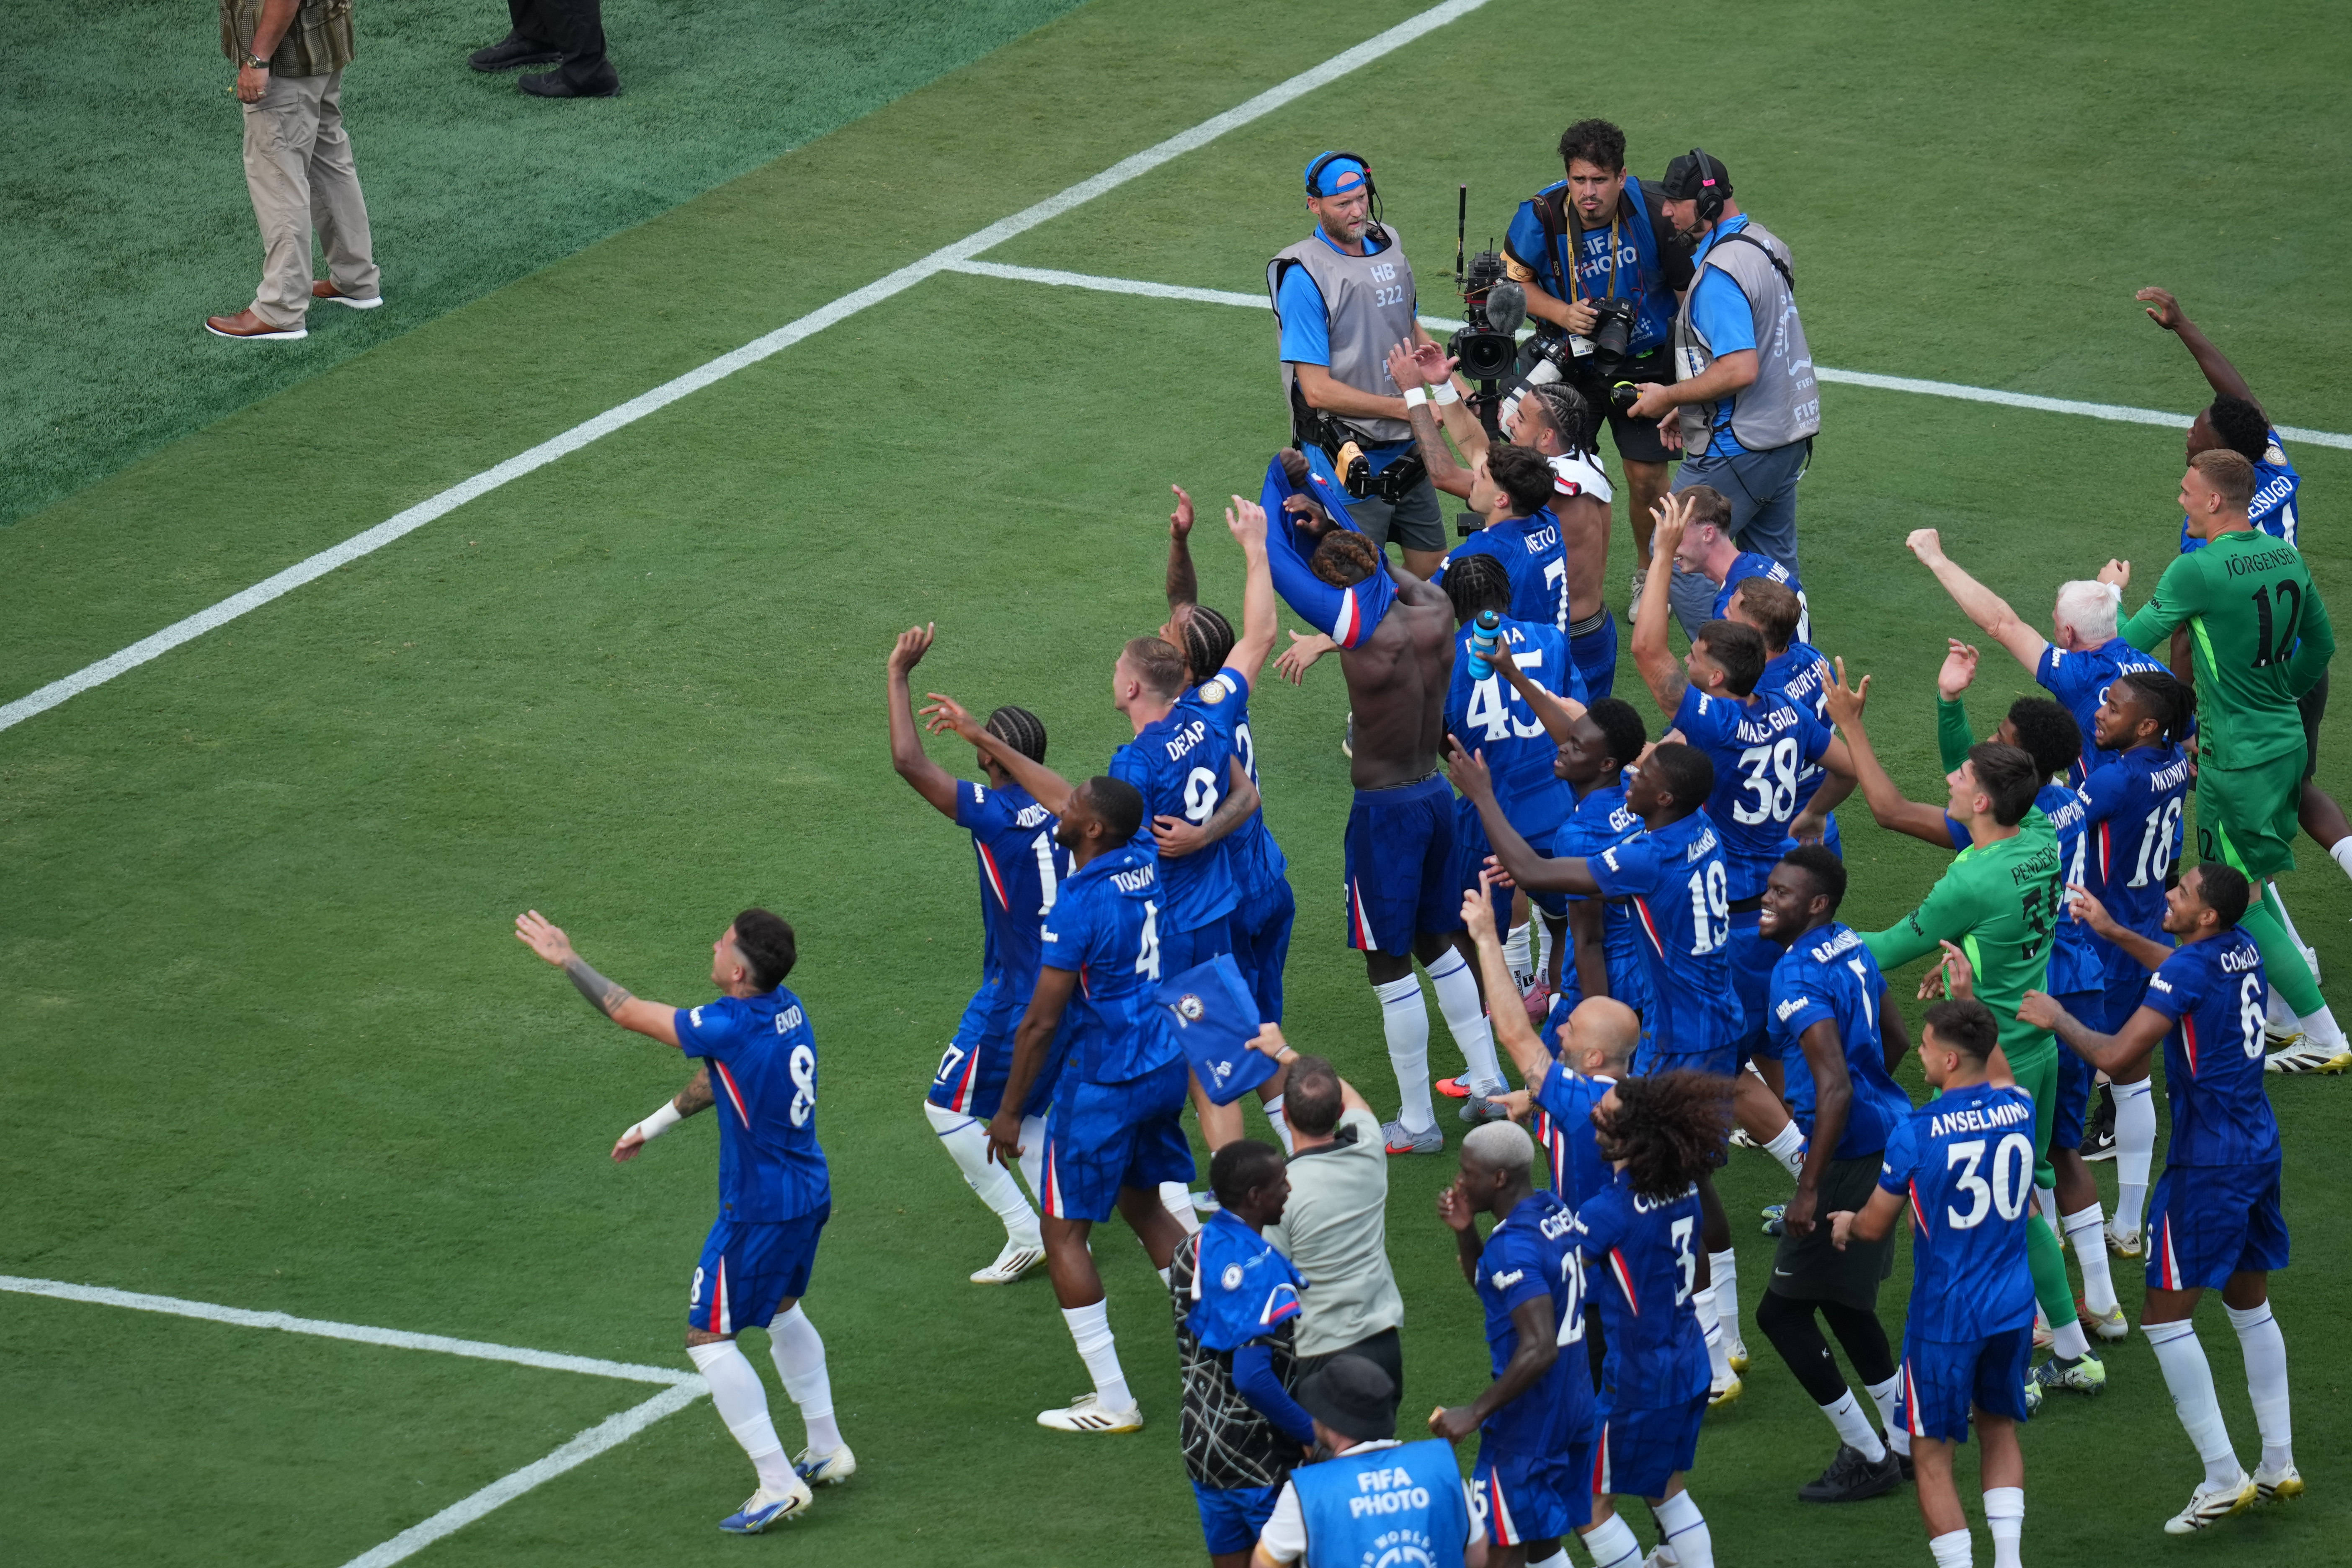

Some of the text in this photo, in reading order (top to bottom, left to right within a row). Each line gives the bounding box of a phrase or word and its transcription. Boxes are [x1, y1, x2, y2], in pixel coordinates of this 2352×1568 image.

[1370, 263, 1396, 283] HB
[1575, 246, 1637, 283] PHOTO
[1375, 285, 1403, 307] 322
[1524, 525, 1555, 554] NETO
[2224, 547, 2298, 580] JÖRGENSEN
[1543, 556, 1569, 633] 7
[2251, 579, 2301, 668] 12
[1466, 648, 1549, 742] 45
[1184, 766, 1219, 825] 9
[1733, 737, 1798, 825] 38
[2126, 796, 2182, 888] 18
[2196, 825, 2216, 862] 12
[1110, 863, 1155, 893] TOSIN
[1688, 859, 1730, 956] 19
[1135, 899, 1160, 981] 4
[775, 1005, 802, 1035] ENZO
[2241, 972, 2267, 1059] 6
[790, 1044, 816, 1127] 8
[938, 1042, 965, 1081] 17
[1947, 1132, 2035, 1230] 30
[691, 1266, 704, 1304] 8
[1671, 1215, 1696, 1307] 3
[1556, 1244, 1587, 1347] 2
[1349, 1486, 1431, 1519] PHOTO
[1357, 1466, 1413, 1493] FIFA
[1374, 1529, 1431, 1549] WORLD
